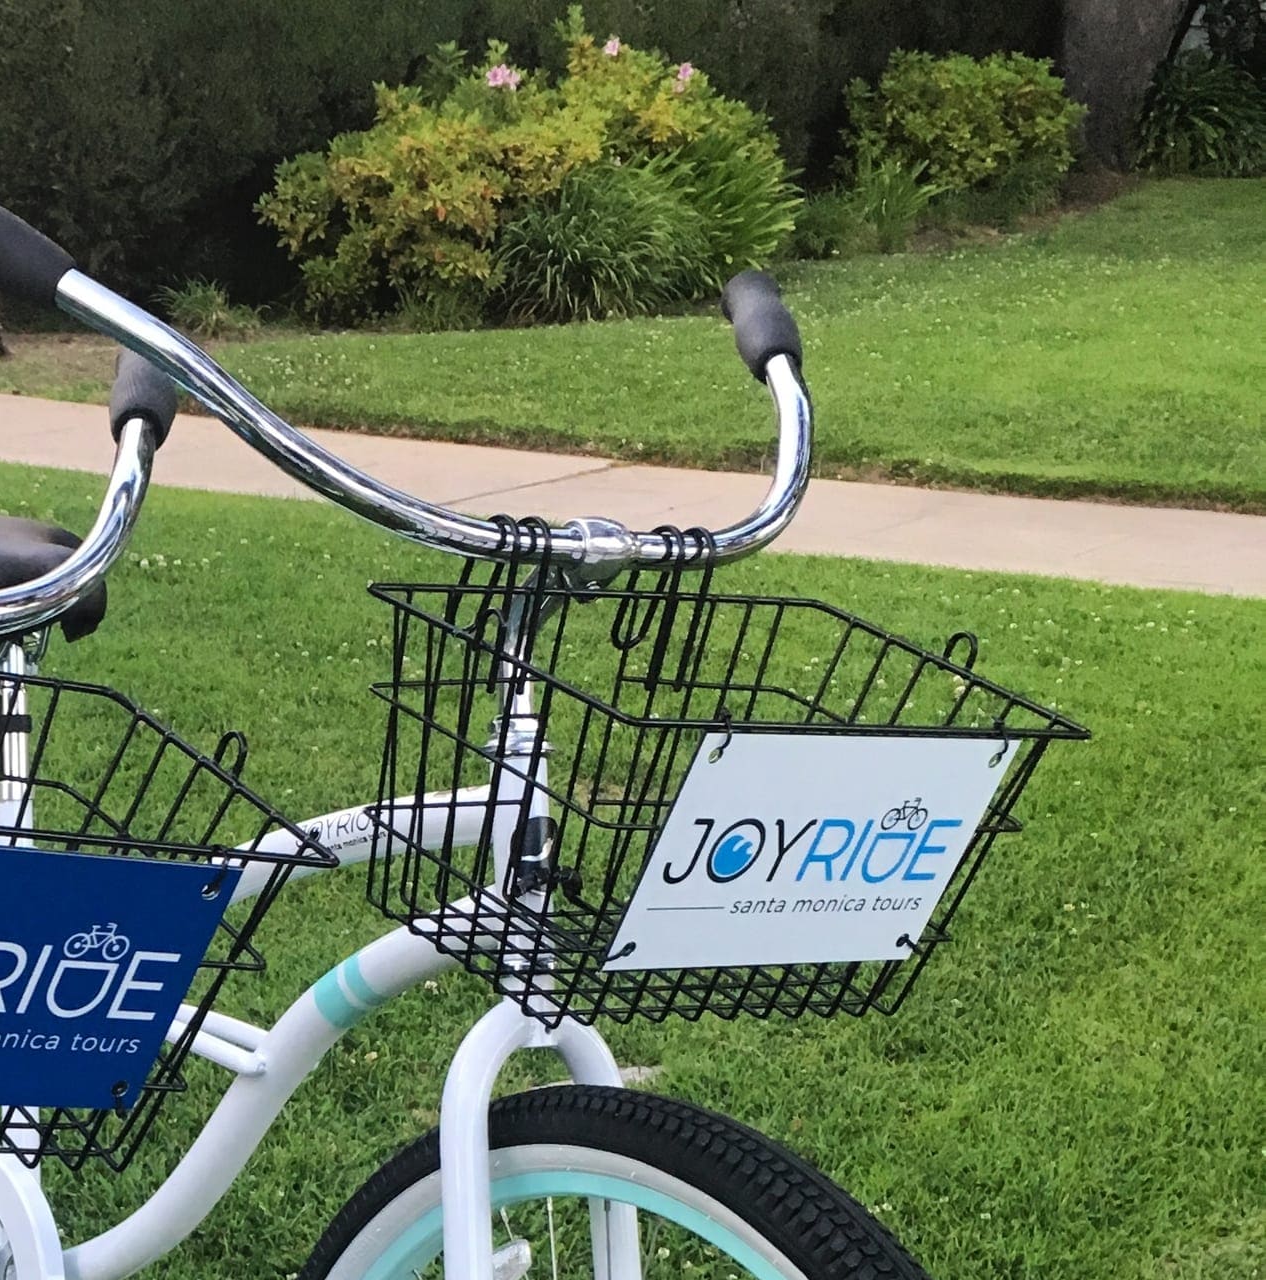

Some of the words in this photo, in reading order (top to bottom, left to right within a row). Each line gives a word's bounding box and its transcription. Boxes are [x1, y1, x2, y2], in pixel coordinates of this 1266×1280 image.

[296, 812, 382, 848] OYRID
[663, 818, 963, 884] JOYRIDE
[730, 897, 787, 914] santa
[792, 896, 866, 913] monica
[872, 895, 922, 911] tours
[71, 1030, 141, 1054] tours
